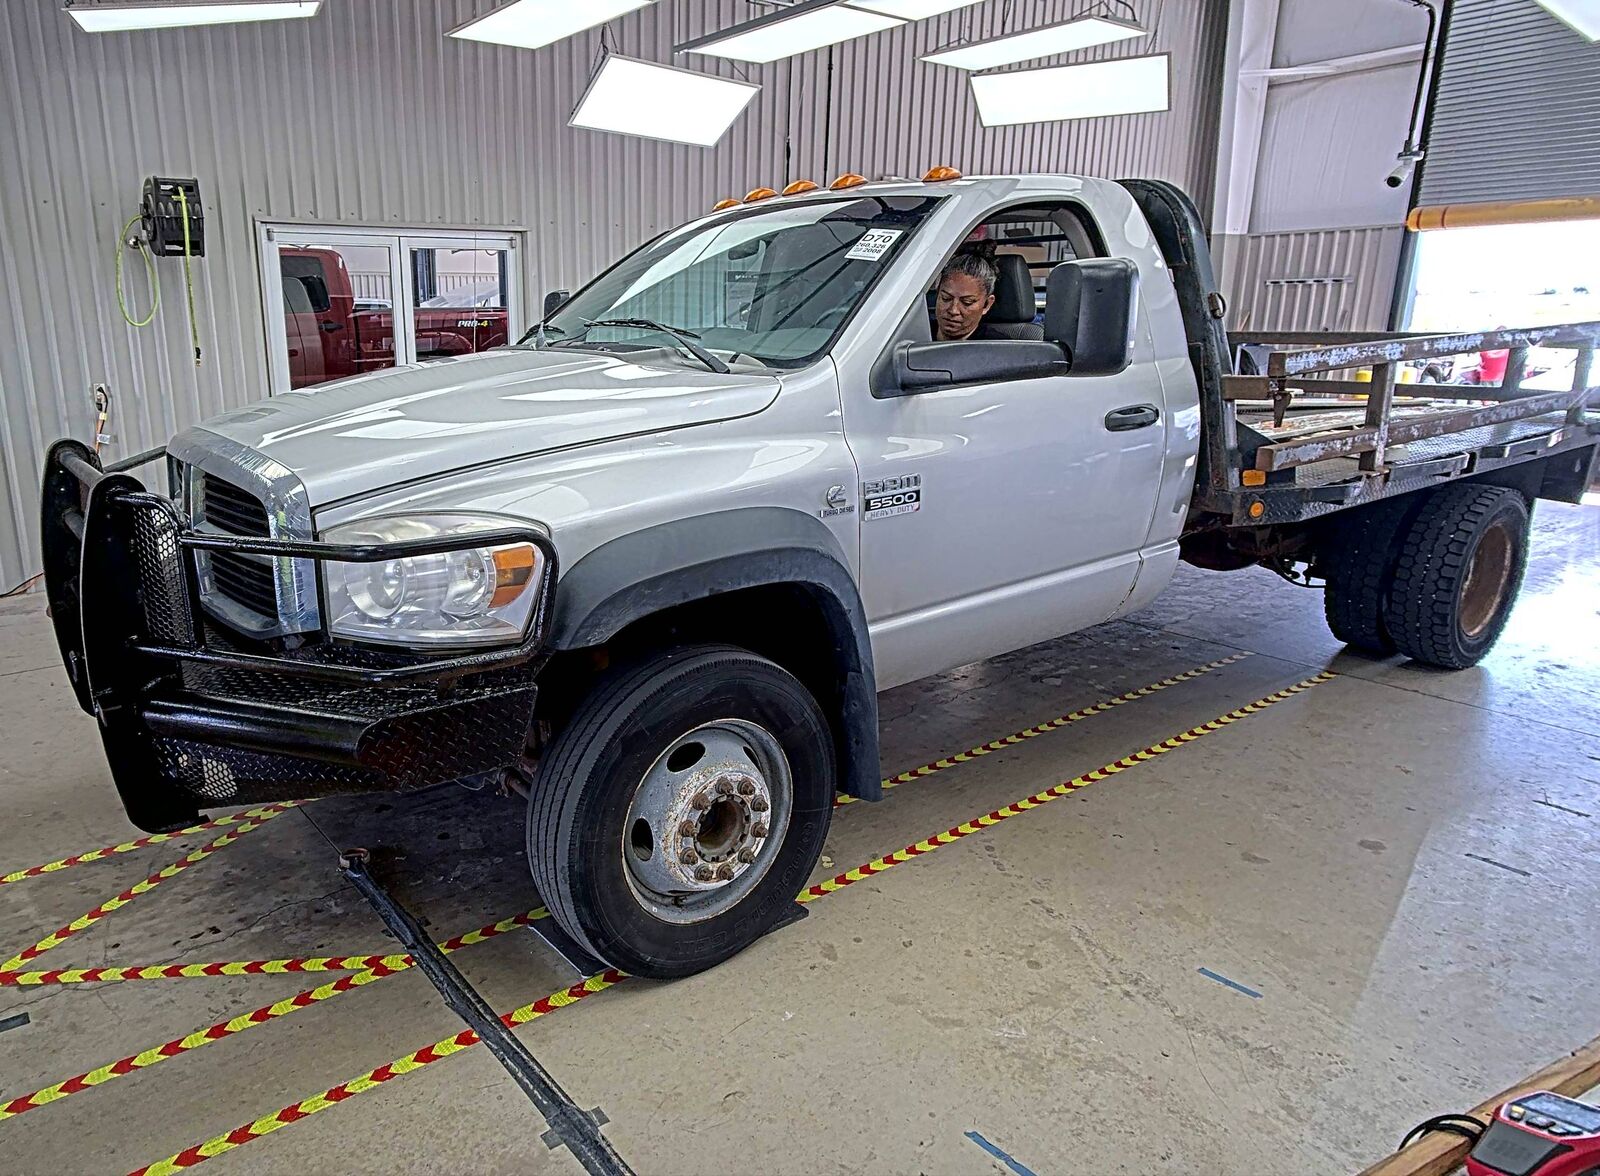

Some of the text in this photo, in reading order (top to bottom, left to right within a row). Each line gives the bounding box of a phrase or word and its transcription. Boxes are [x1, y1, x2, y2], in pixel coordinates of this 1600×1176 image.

[862, 234, 893, 243] D70
[870, 493, 917, 510] 5500
[870, 504, 915, 518] HEAVY DUTY
